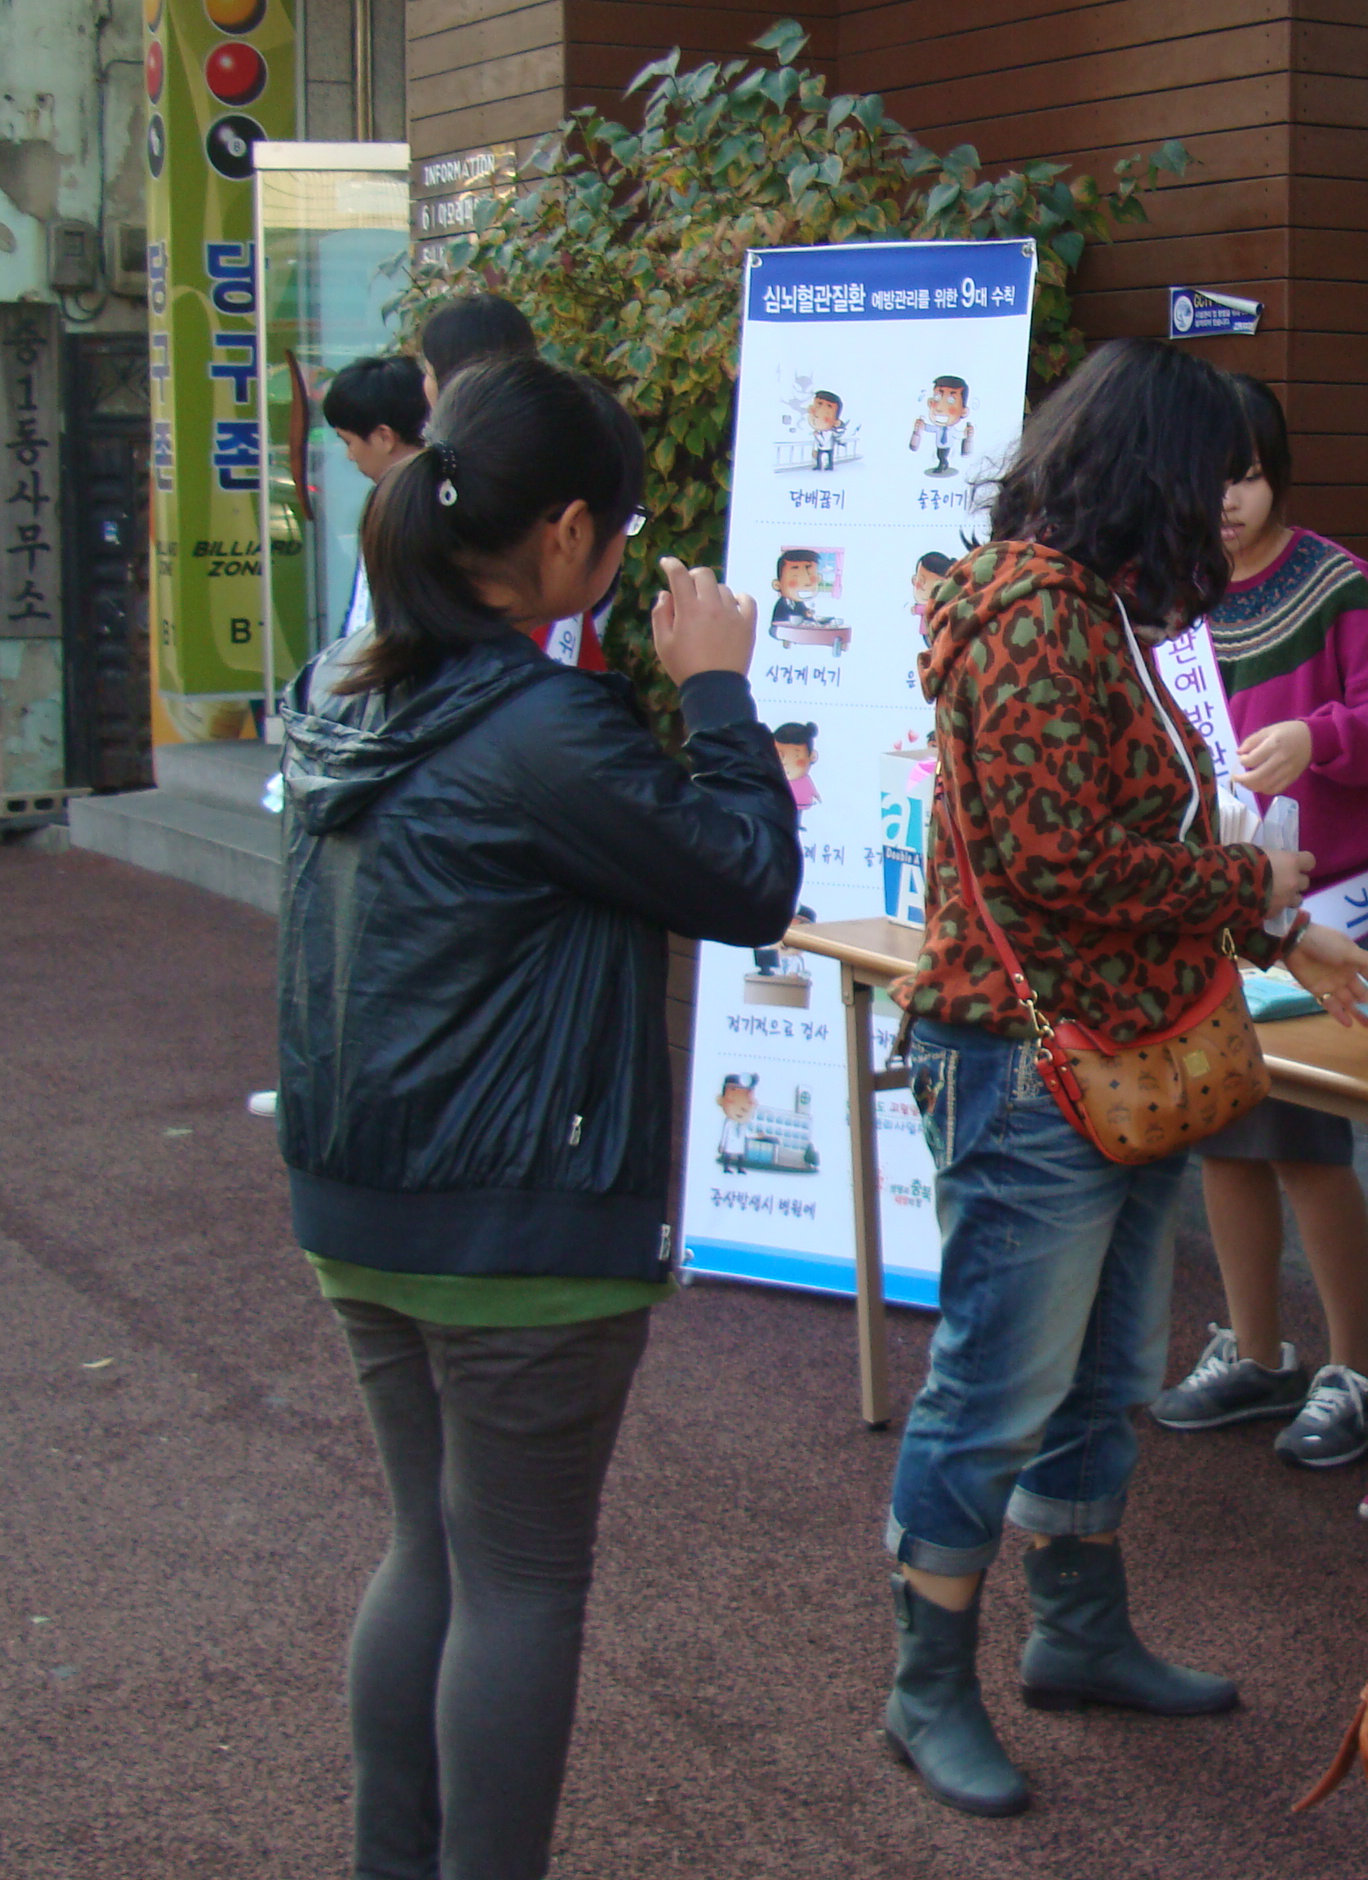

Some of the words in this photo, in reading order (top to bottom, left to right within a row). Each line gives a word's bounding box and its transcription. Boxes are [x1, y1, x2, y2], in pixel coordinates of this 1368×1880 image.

[424, 154, 496, 187] INFORMATION
[763, 283, 866, 314] 심뇌혈관질환
[871, 289, 930, 311] 예방관리를
[934, 288, 957, 309] 위한
[961, 277, 987, 308] 9대
[992, 285, 1015, 307] 수칙
[205, 241, 262, 492] 당구존
[765, 665, 808, 686] 싱겁게
[813, 667, 841, 688] 먹기
[822, 844, 845, 866] 유지
[726, 1015, 794, 1040] 정기적으로
[801, 1020, 829, 1041] 검사
[778, 1198, 817, 1220] 병원에
